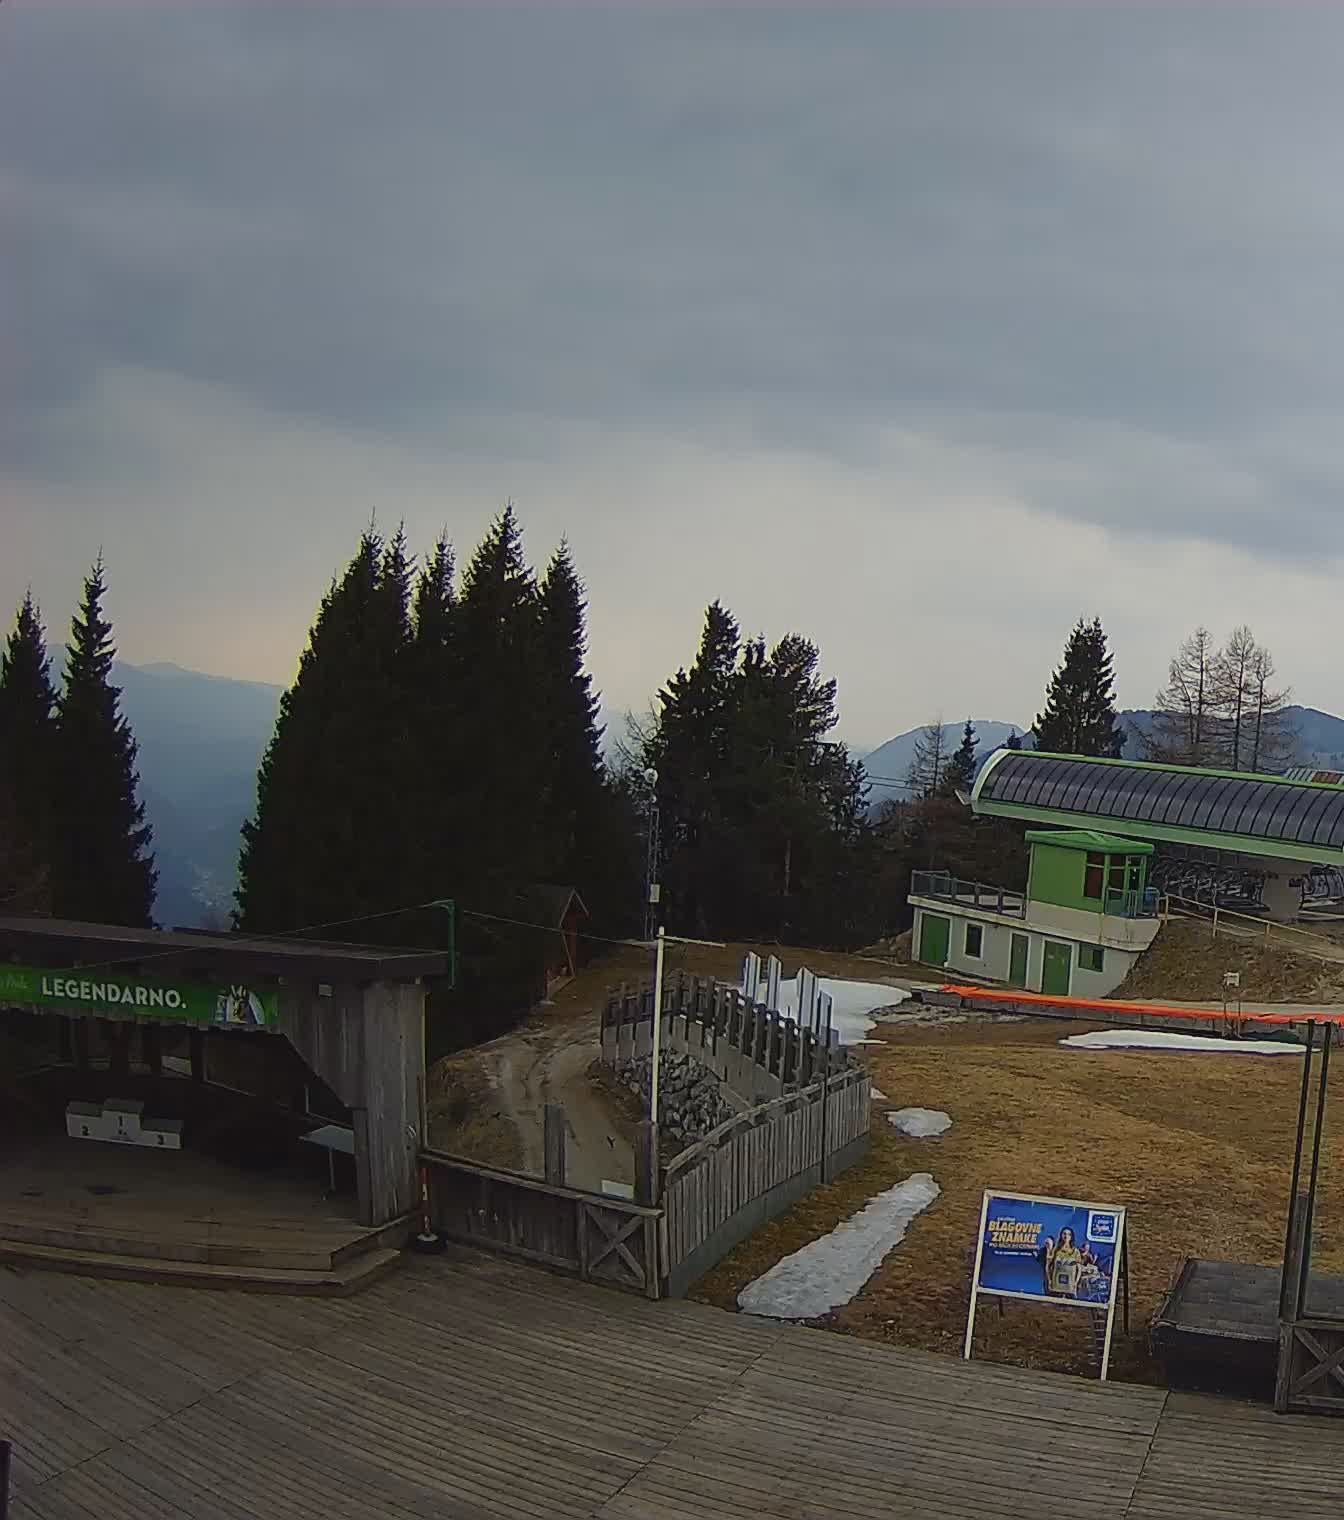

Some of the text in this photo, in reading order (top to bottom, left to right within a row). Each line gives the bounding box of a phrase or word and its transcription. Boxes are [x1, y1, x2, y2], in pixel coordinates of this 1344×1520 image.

[42, 976, 187, 1009] LEGENDARNO.
[81, 1126, 90, 1136] 2
[157, 1134, 164, 1145] 3
[991, 1231, 1038, 1243] ZNAMKE
